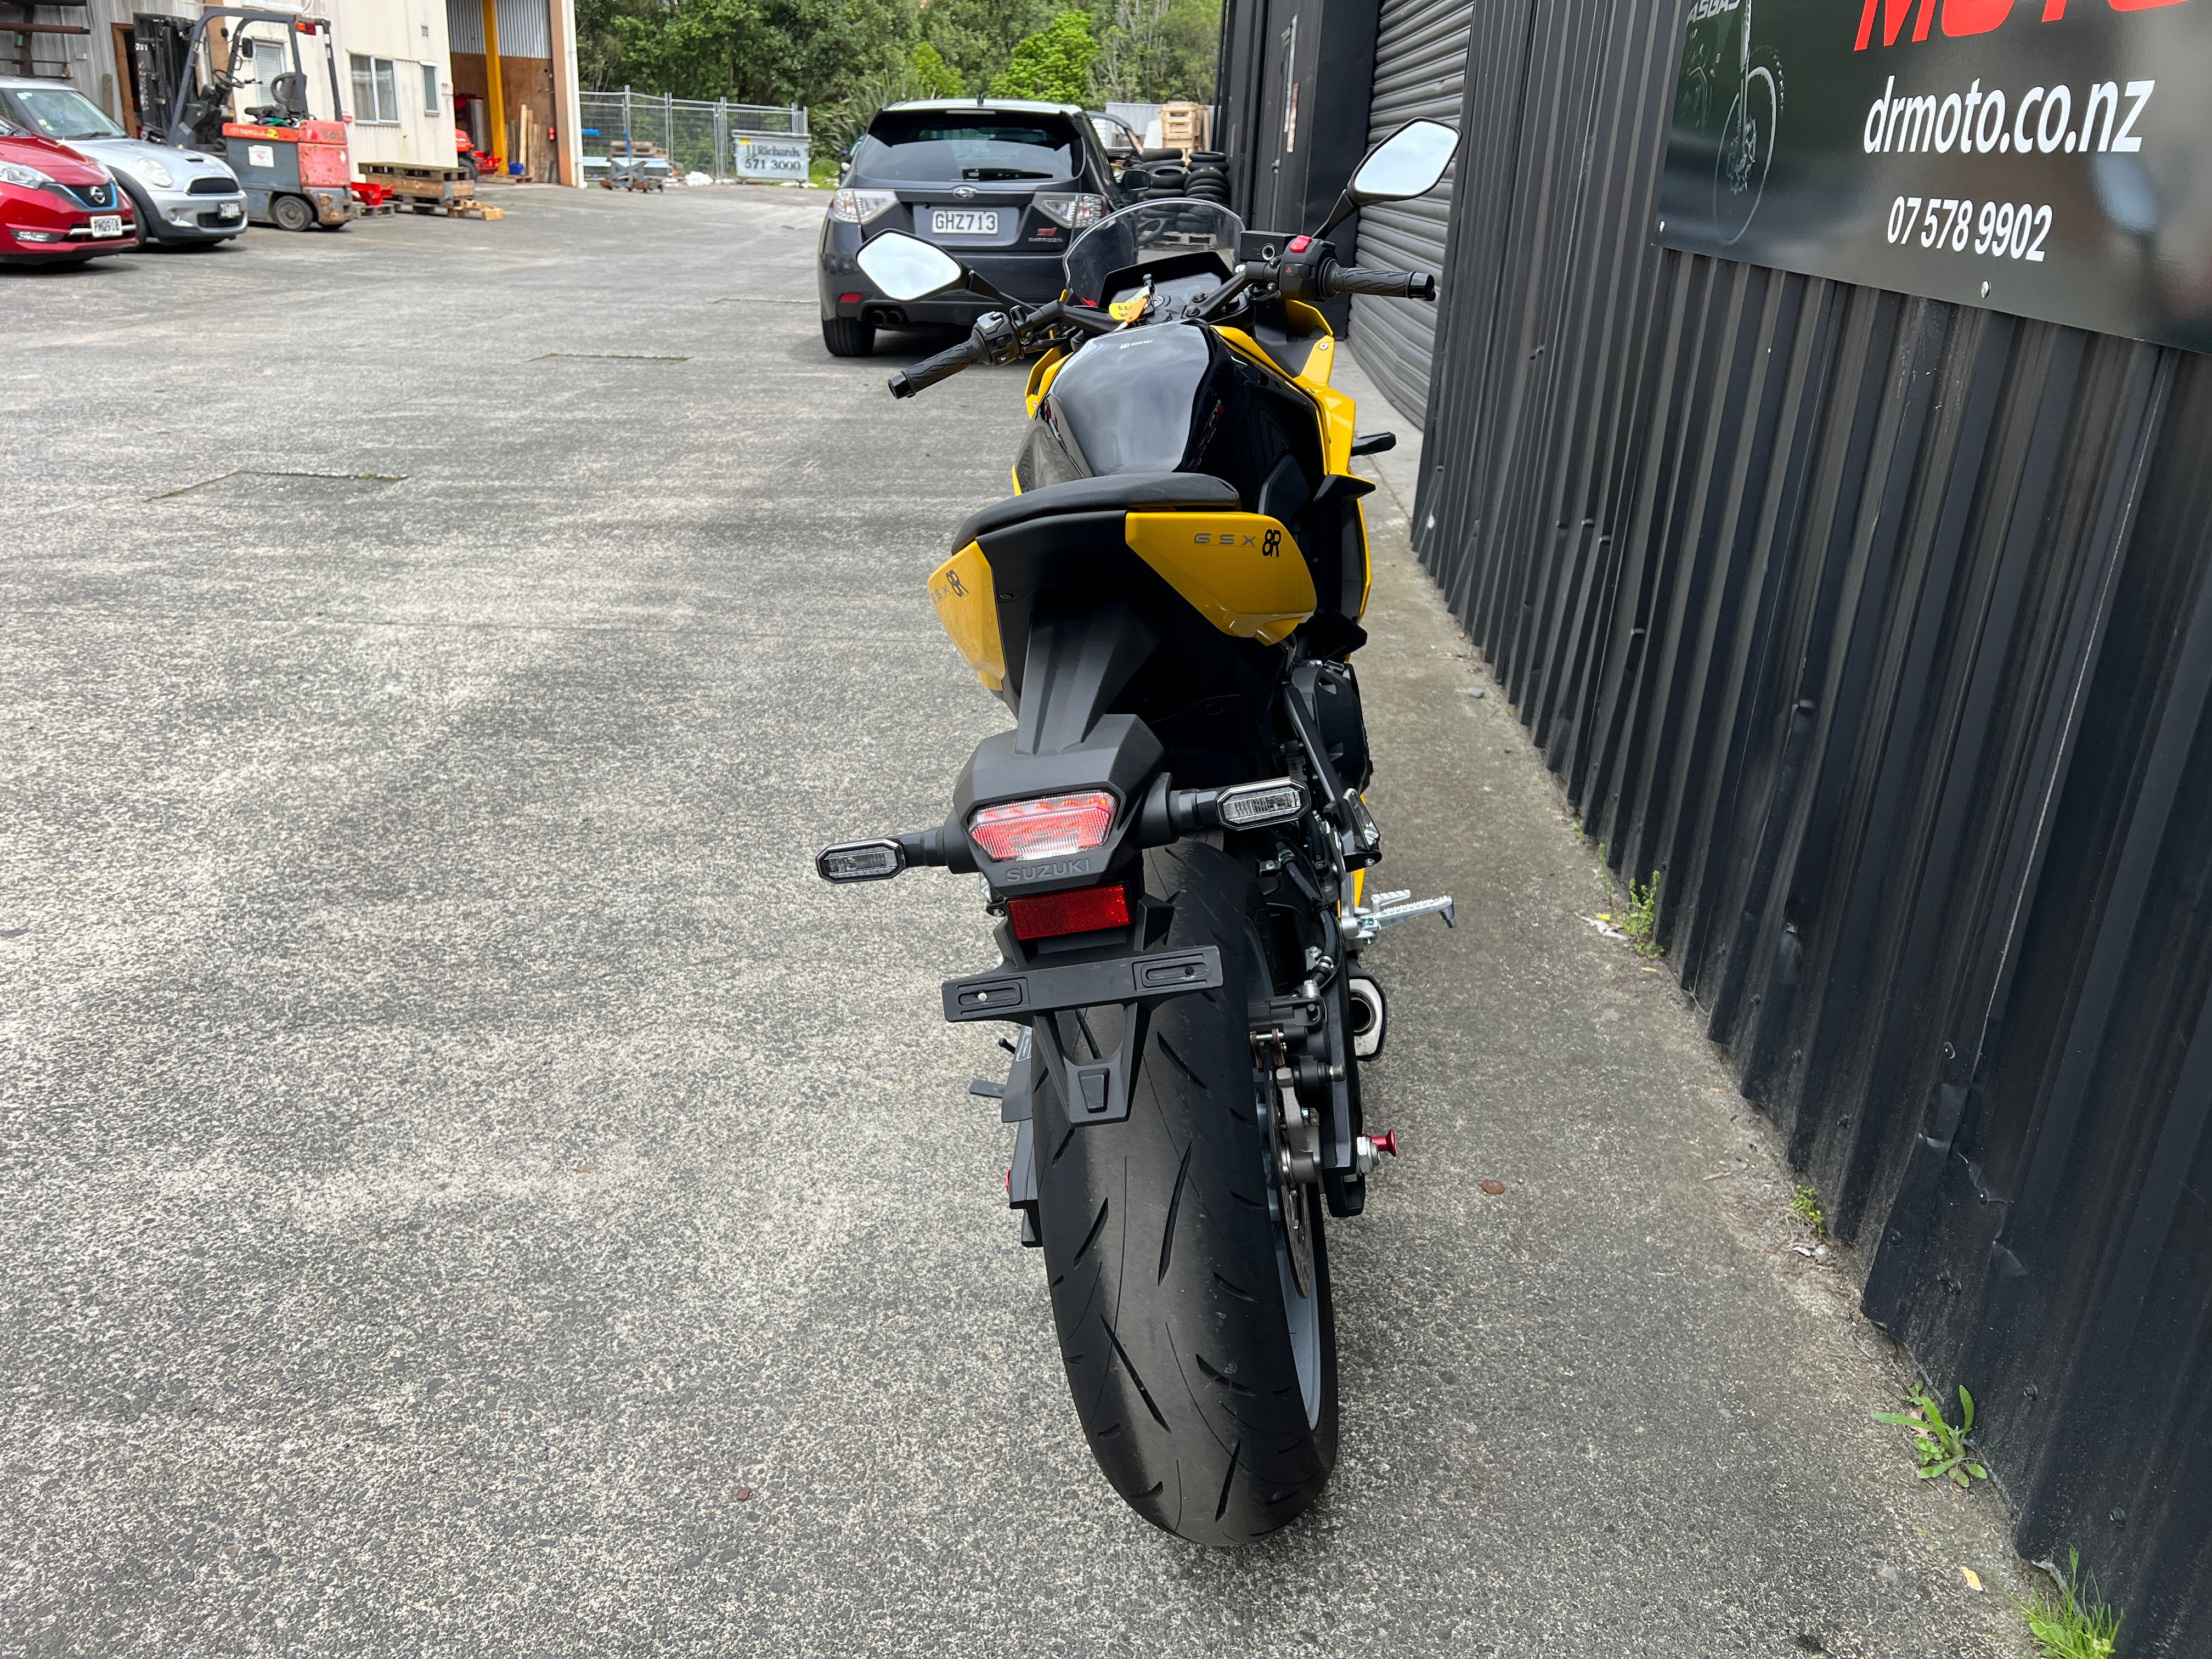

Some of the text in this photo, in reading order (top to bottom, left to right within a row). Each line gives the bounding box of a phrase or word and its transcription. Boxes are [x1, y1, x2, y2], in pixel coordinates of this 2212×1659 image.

[1865, 75, 2155, 153] drmoto.co.nz
[744, 159, 800, 171] 571 3000
[935, 213, 996, 230] GHZ713
[1887, 196, 2052, 262] 07 578 9902
[1194, 528, 1282, 557] GSX 8R
[1006, 857, 1091, 882] SUZUKI
